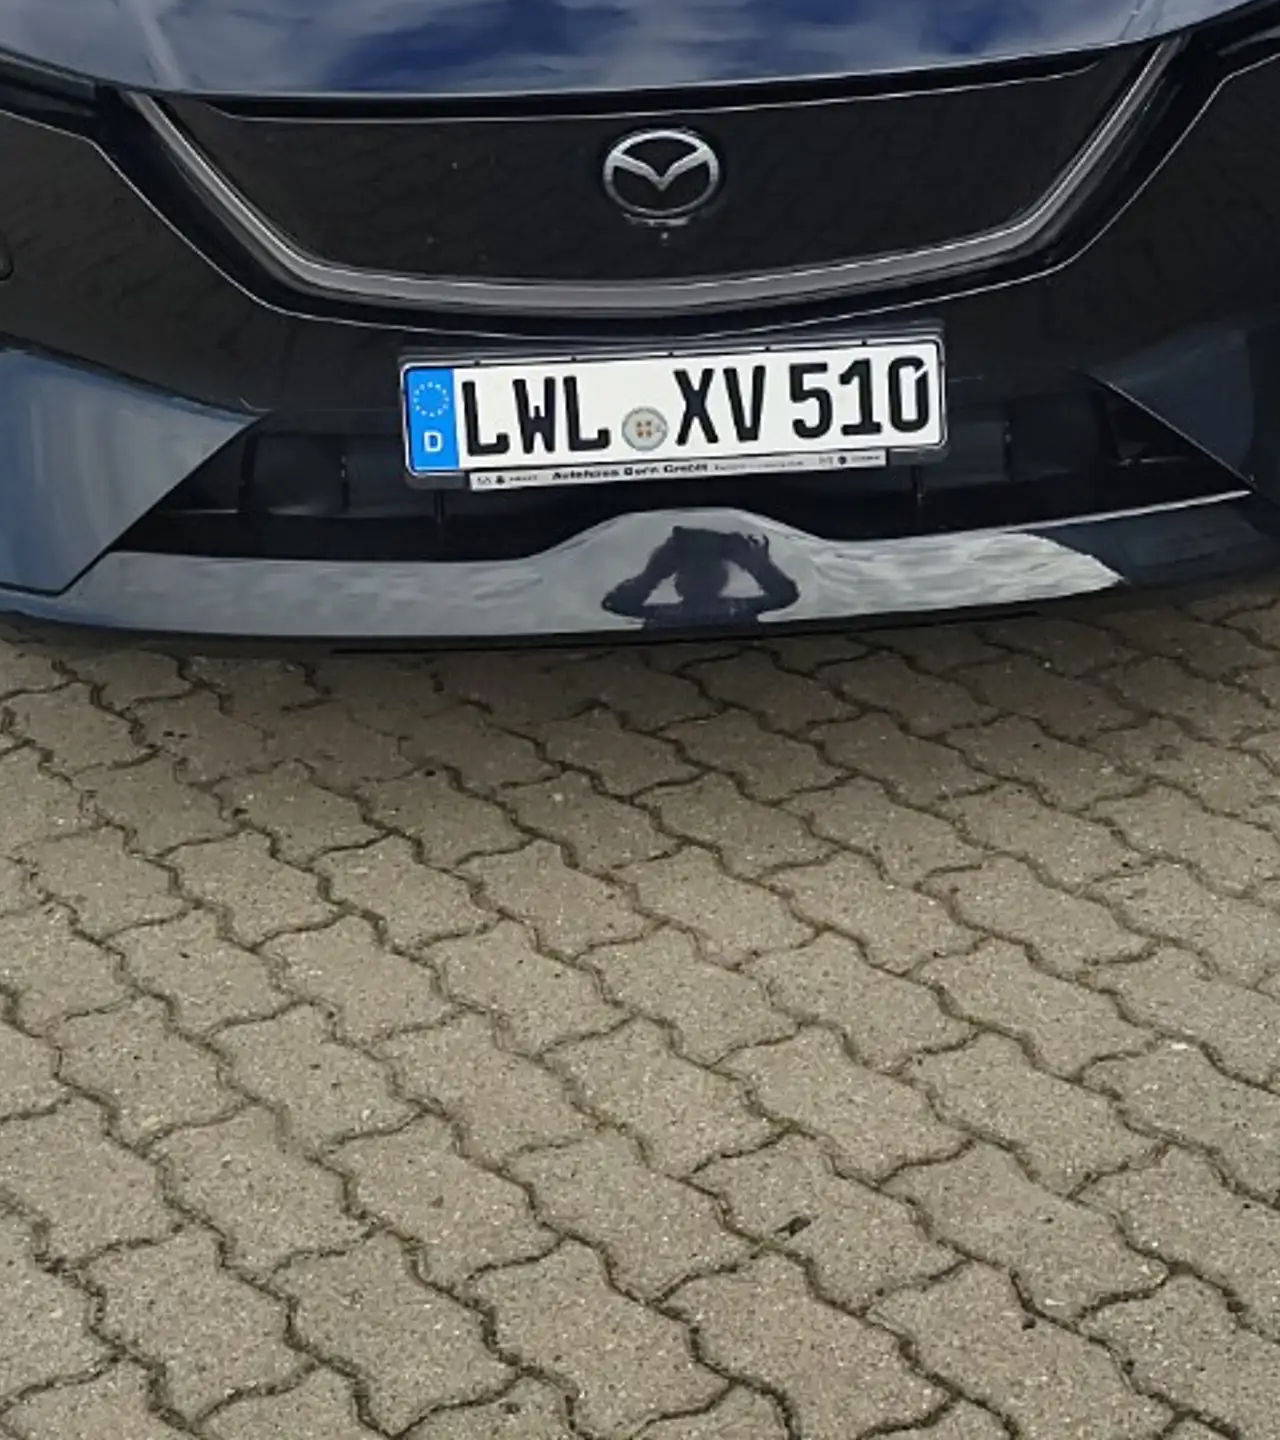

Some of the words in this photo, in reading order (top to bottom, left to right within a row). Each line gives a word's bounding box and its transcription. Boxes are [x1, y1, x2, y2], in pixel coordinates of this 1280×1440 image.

[462, 375, 611, 457] LWL
[673, 365, 767, 446] XV
[788, 356, 930, 440] 510
[424, 430, 443, 452] D
